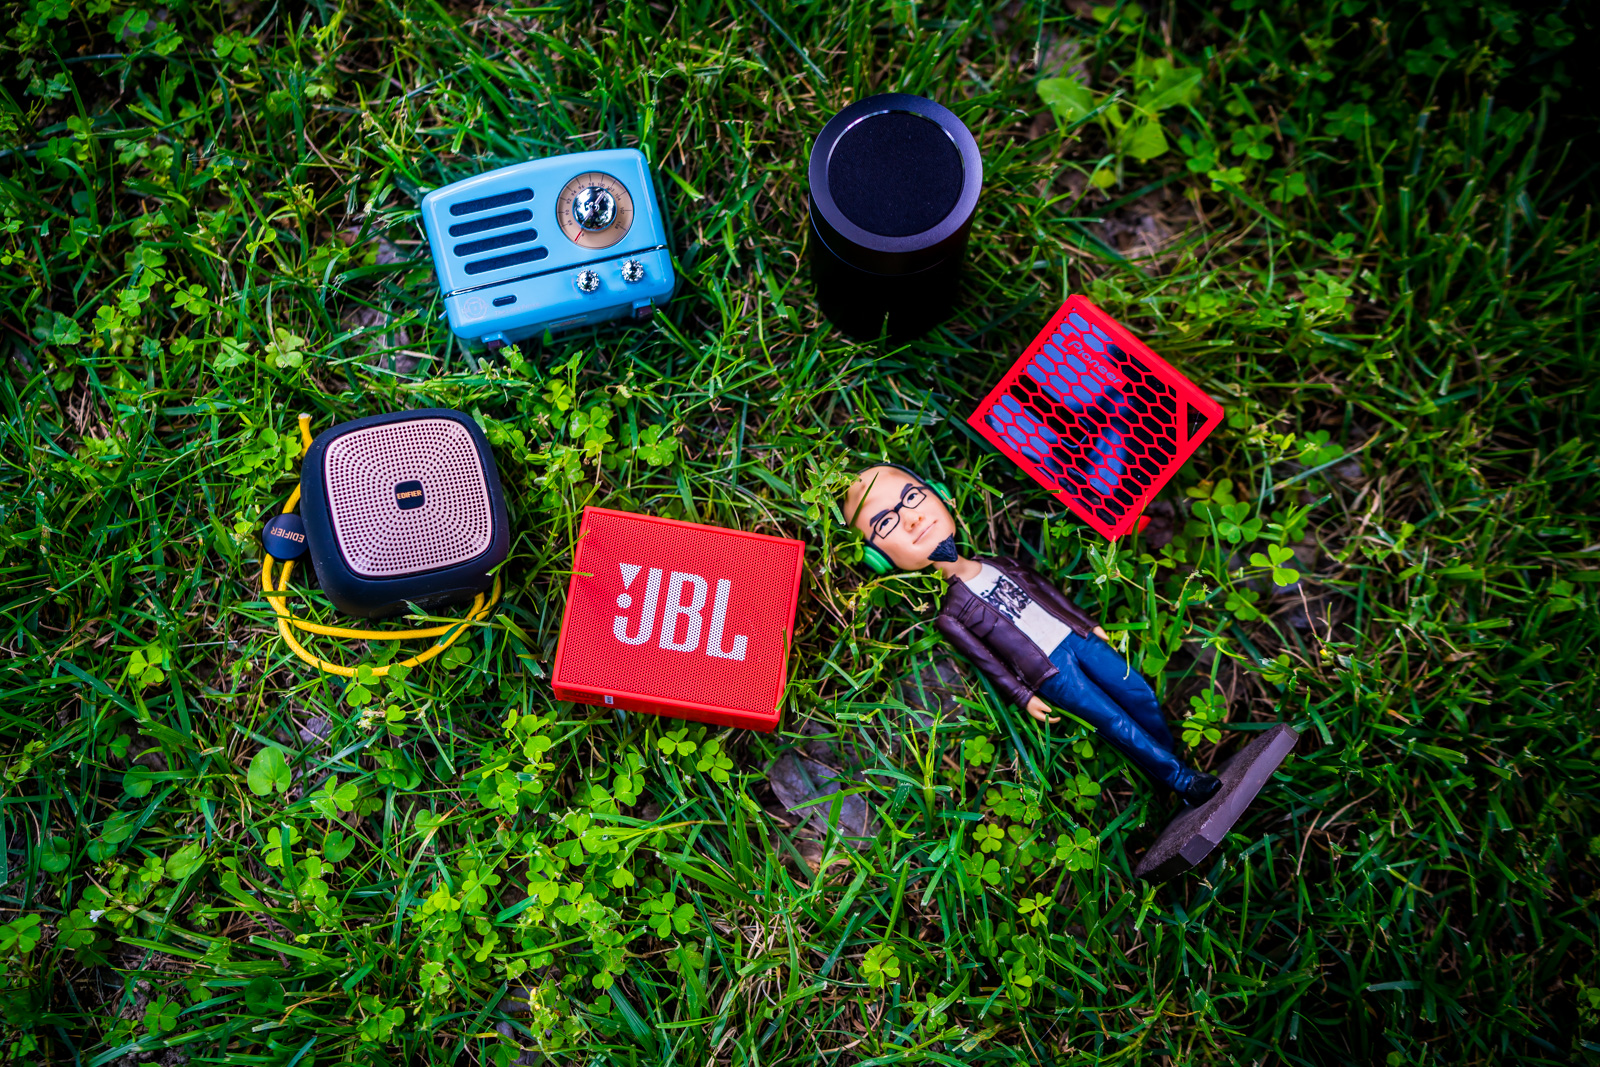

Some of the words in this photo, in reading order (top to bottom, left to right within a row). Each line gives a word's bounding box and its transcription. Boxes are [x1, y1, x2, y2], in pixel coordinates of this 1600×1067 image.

[1067, 340, 1123, 384] Pioneer
[396, 489, 423, 500] EDIFIER
[270, 526, 305, 543] EDIFIER
[612, 563, 748, 661] JBL
